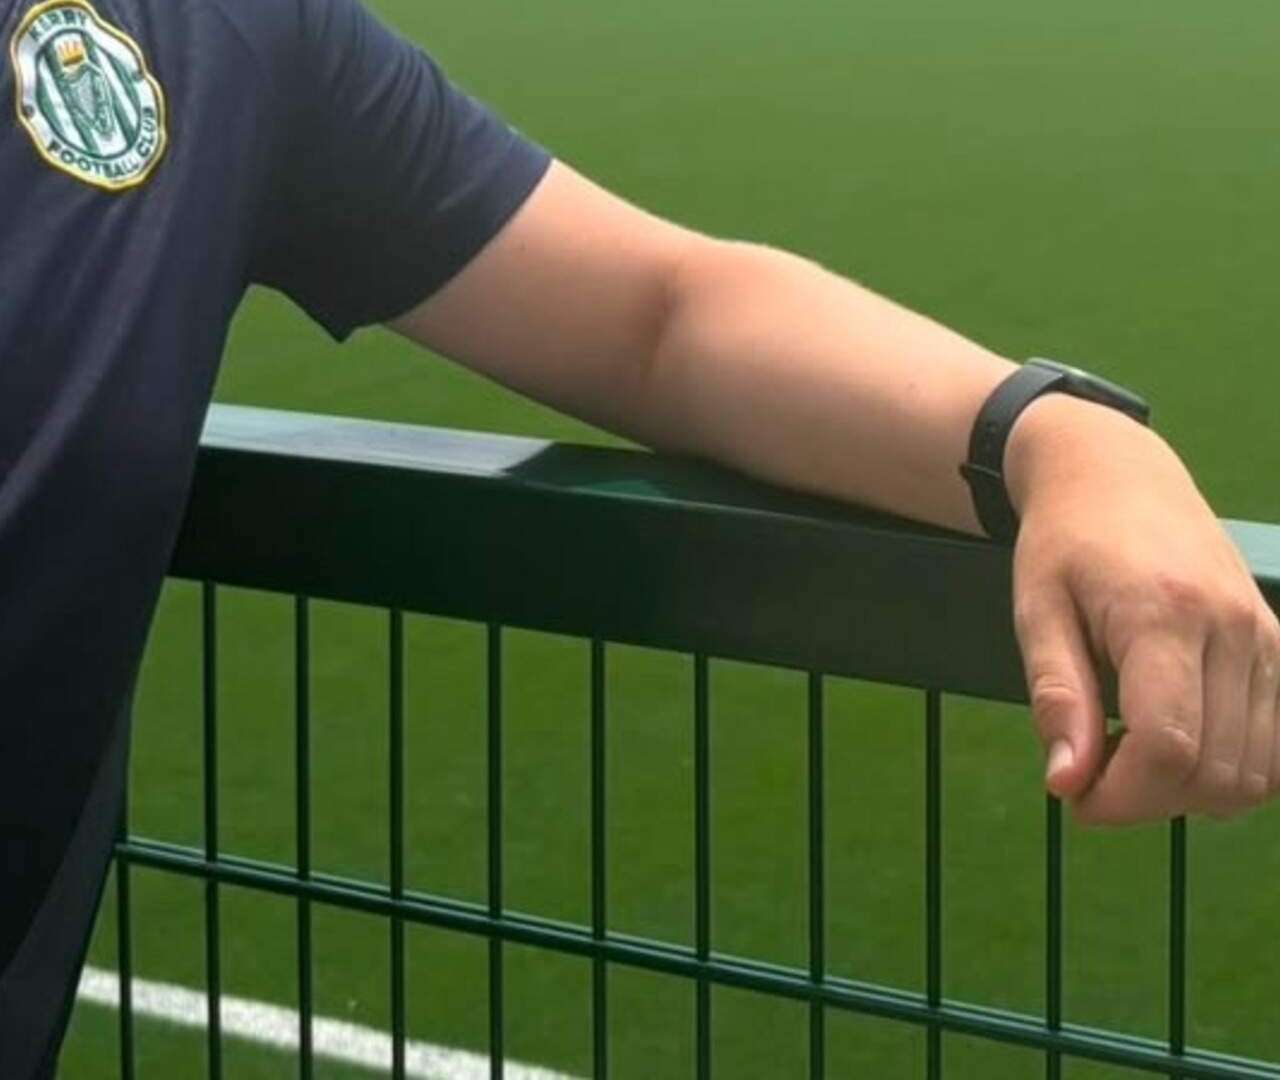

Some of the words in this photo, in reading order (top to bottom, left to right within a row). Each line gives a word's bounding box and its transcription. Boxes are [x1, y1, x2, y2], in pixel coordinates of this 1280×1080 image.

[28, 8, 87, 42] KERRY
[47, 140, 140, 178] FOOTBALL
[136, 106, 158, 158] CLUB
